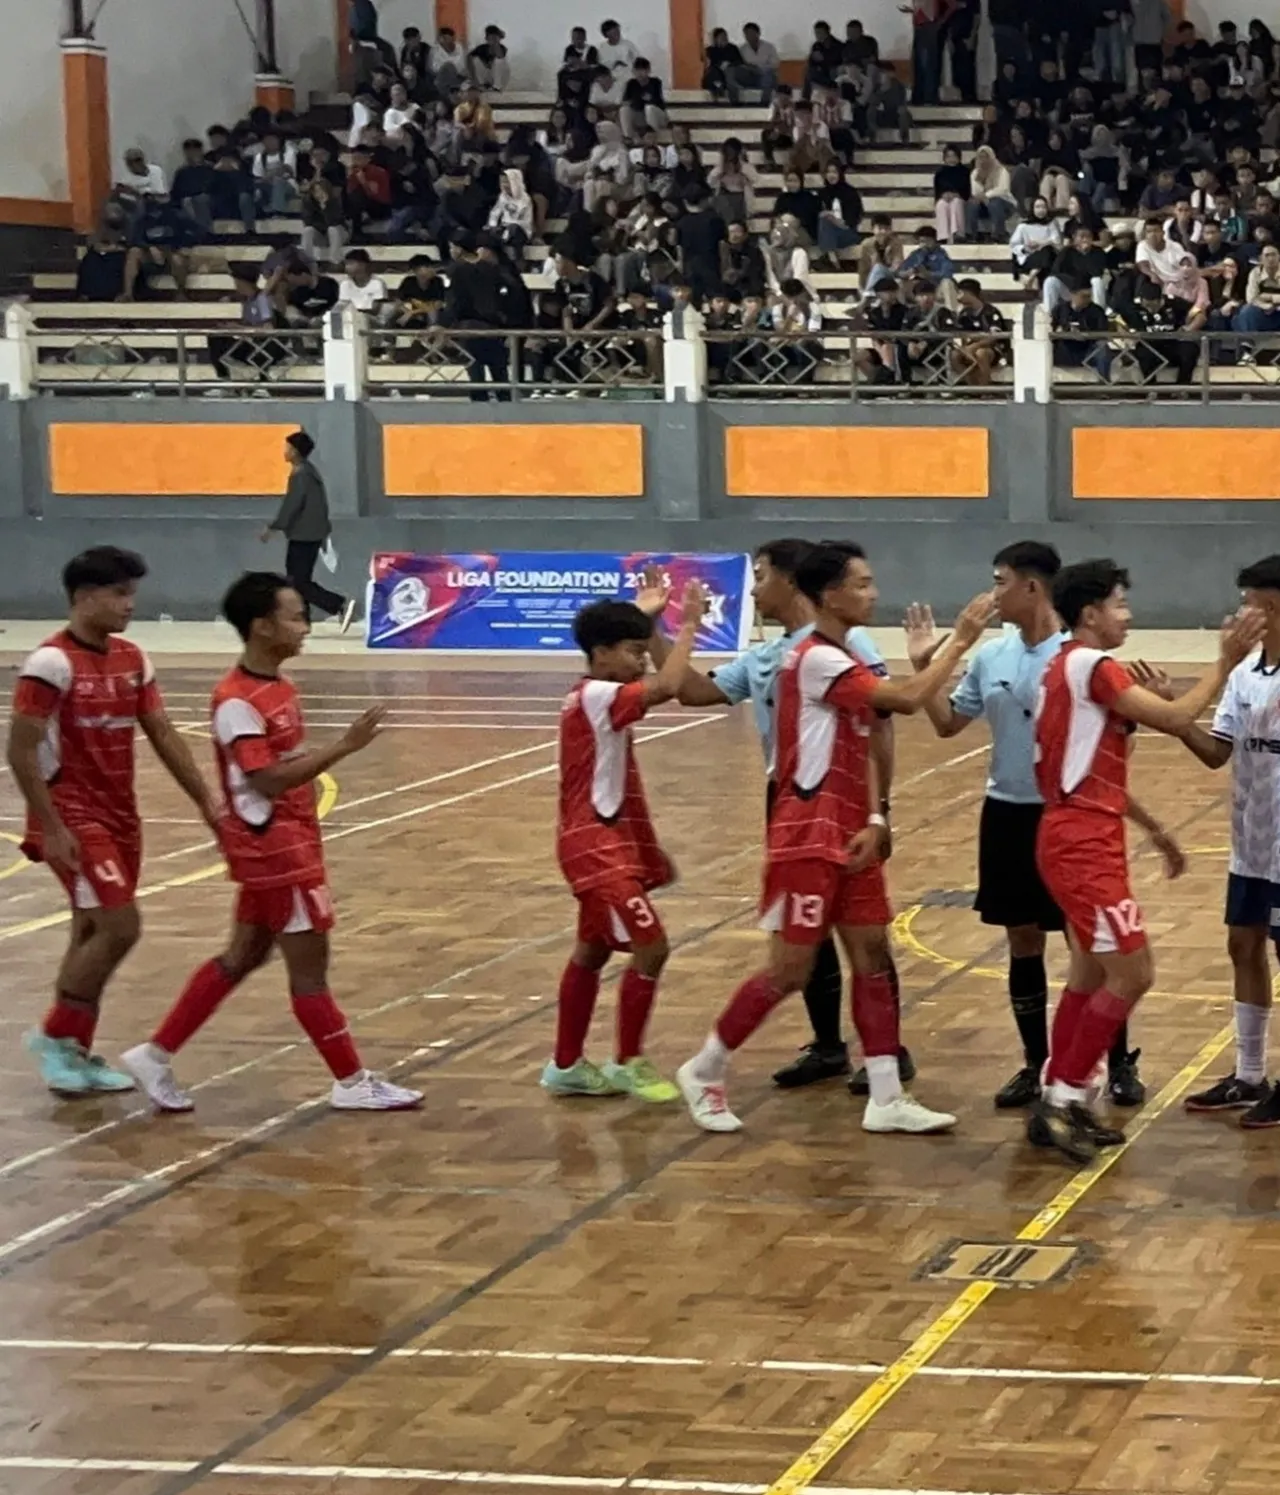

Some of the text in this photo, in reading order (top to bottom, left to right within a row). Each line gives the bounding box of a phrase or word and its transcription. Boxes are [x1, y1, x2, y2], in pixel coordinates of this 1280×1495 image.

[447, 571, 491, 588] LIGA
[494, 571, 620, 588] FOUNDATION
[94, 859, 126, 887] 4
[626, 897, 655, 928] 3
[790, 893, 824, 928] 13
[1106, 899, 1144, 936] 12
